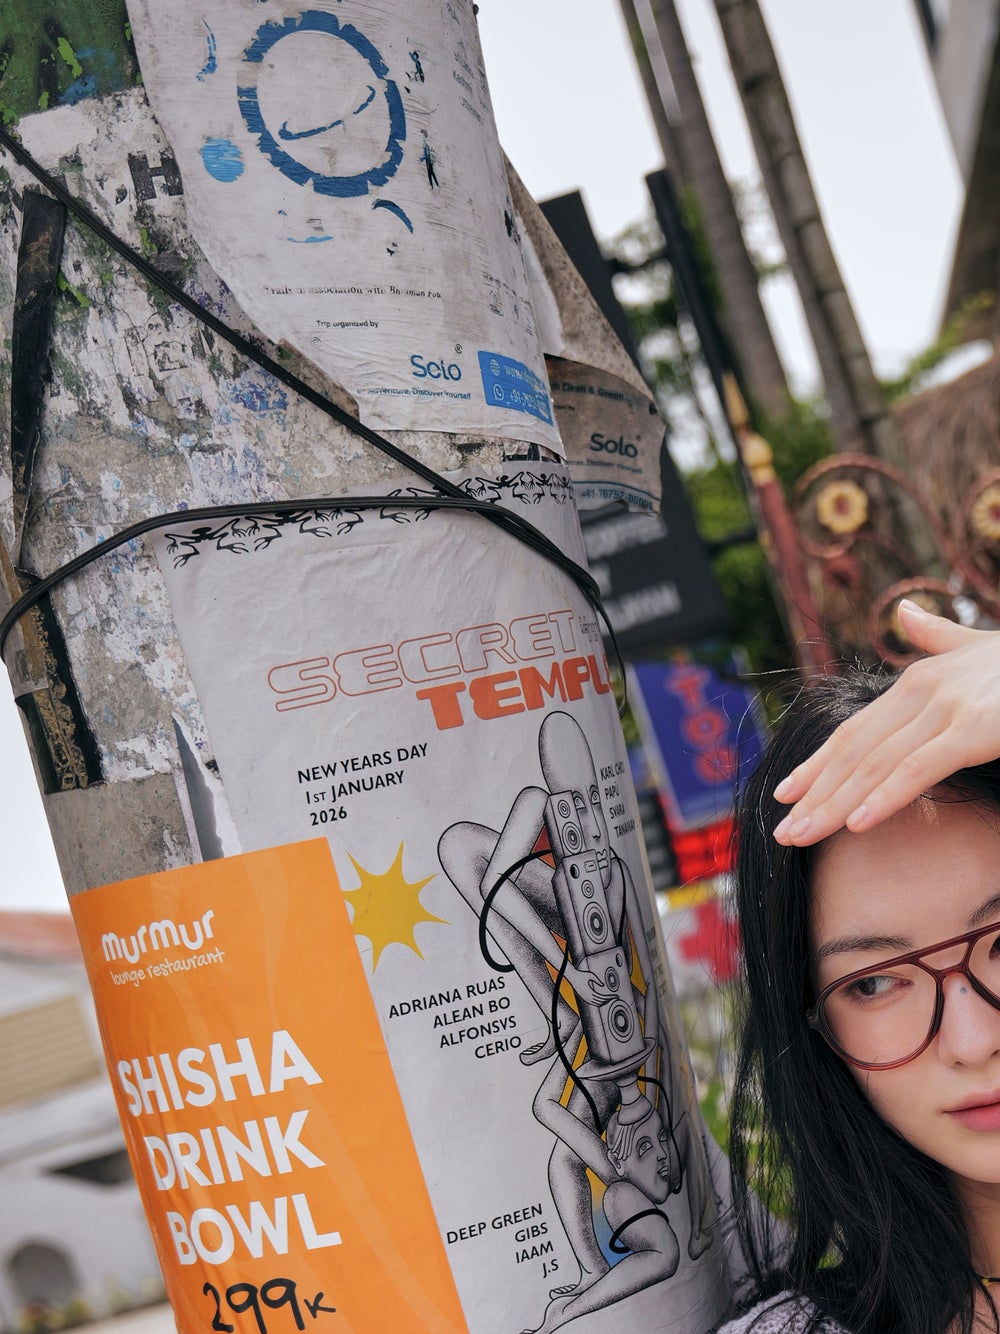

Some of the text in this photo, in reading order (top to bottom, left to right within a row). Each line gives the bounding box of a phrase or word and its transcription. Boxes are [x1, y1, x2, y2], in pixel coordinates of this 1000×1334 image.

[316, 320, 331, 329] Trip
[369, 320, 379, 329] by
[590, 433, 638, 459] Solo
[267, 608, 578, 712] SECRET
[297, 742, 428, 783] NEW YEARS DAY
[331, 770, 405, 803] JANUARY
[309, 806, 348, 826] 2026
[101, 909, 215, 964] murmur
[110, 947, 225, 988] lounge restaurant
[389, 976, 506, 1019] ADRIANA RUAS
[433, 997, 511, 1029] ALEAN BO
[440, 1016, 517, 1049] ALFONSVS
[474, 1036, 521, 1059] CERIO
[117, 1028, 323, 1118] SHISHA
[143, 1109, 326, 1192] DRINK
[165, 1192, 343, 1267] BOWL
[446, 1203, 543, 1244] DEEP GREEN
[514, 1222, 548, 1242] GIBS
[515, 1241, 554, 1264] IAAM
[542, 1258, 559, 1278] J.S
